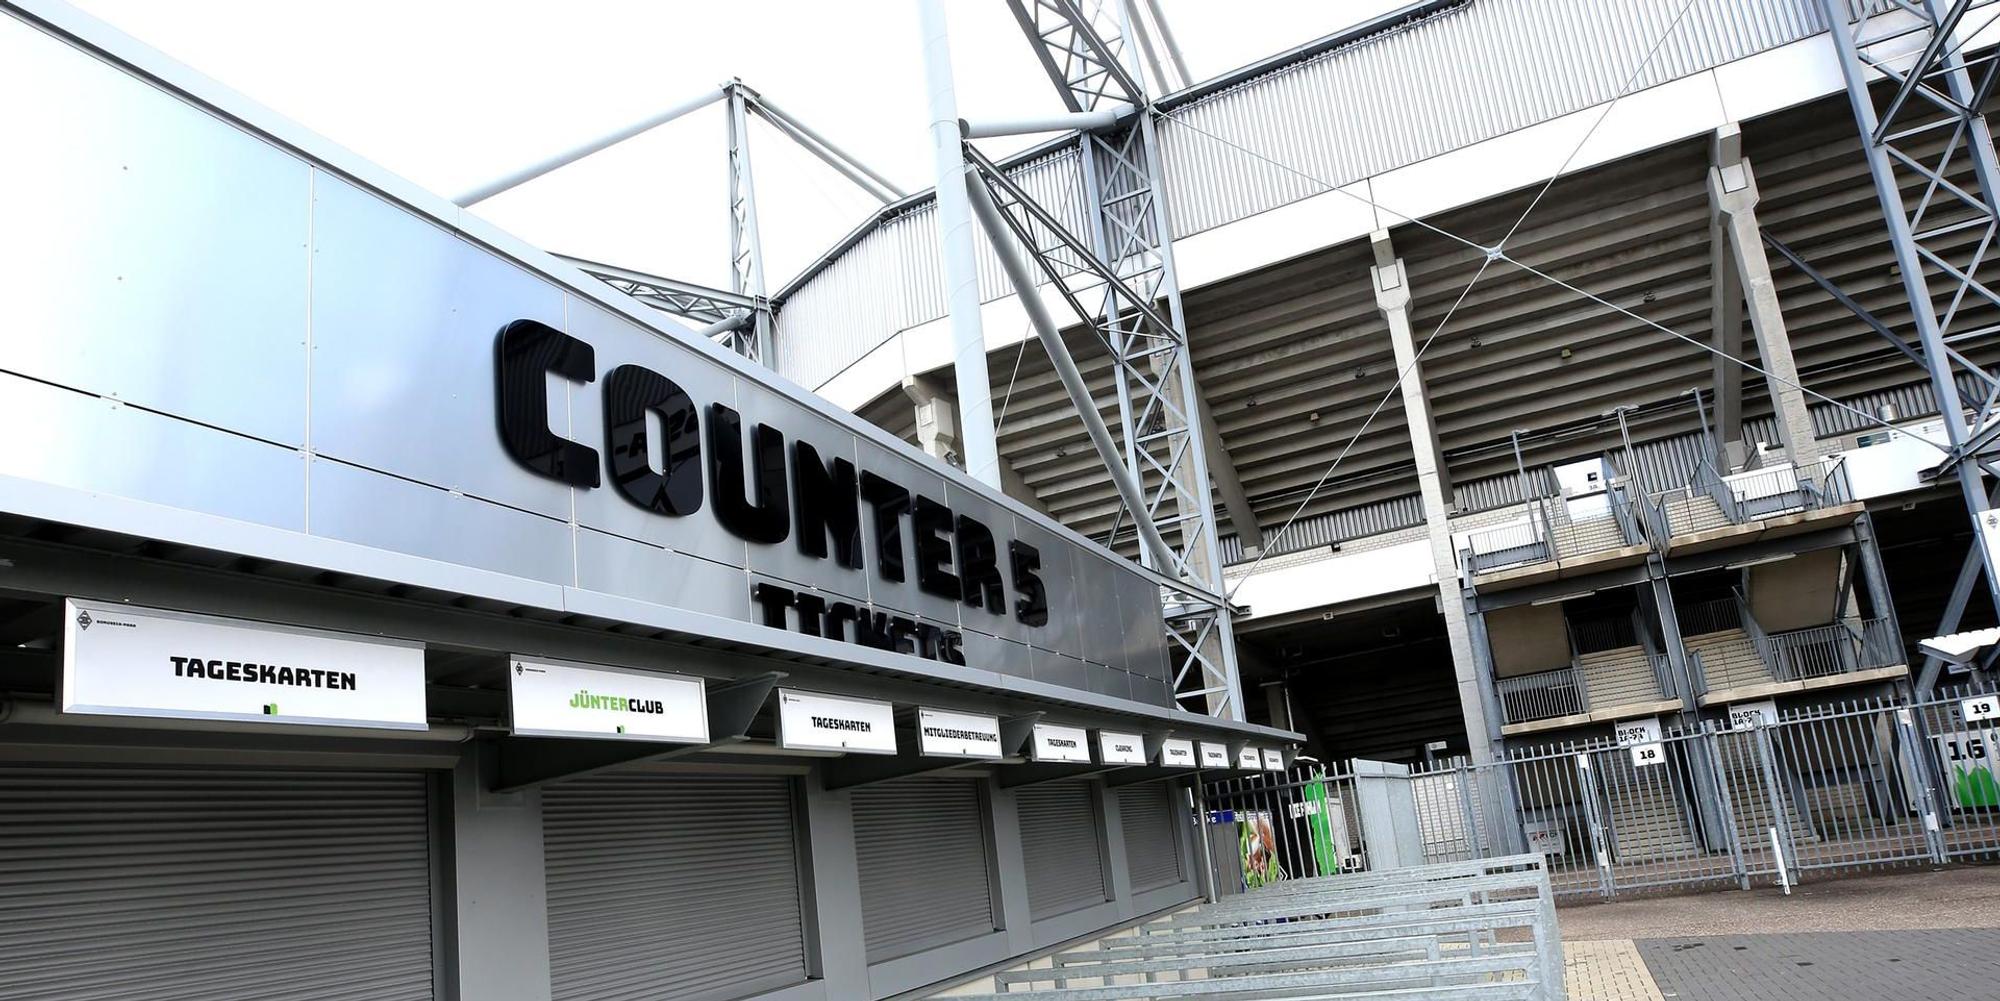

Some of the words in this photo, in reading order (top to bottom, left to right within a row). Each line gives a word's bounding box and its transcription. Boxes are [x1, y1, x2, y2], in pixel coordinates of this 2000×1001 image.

[497, 318, 1005, 615] COUNTER
[1011, 539, 1048, 627] 5
[757, 582, 966, 667] TICKETS
[170, 656, 356, 691] TAGESKARTEN
[569, 689, 664, 715] JÜNTERCLUB
[1972, 703, 1991, 714] 19
[811, 716, 871, 733] TAGESKARTEN
[923, 726, 998, 743] MITGLIEDERBETREUUNG
[1639, 749, 1656, 760] 18
